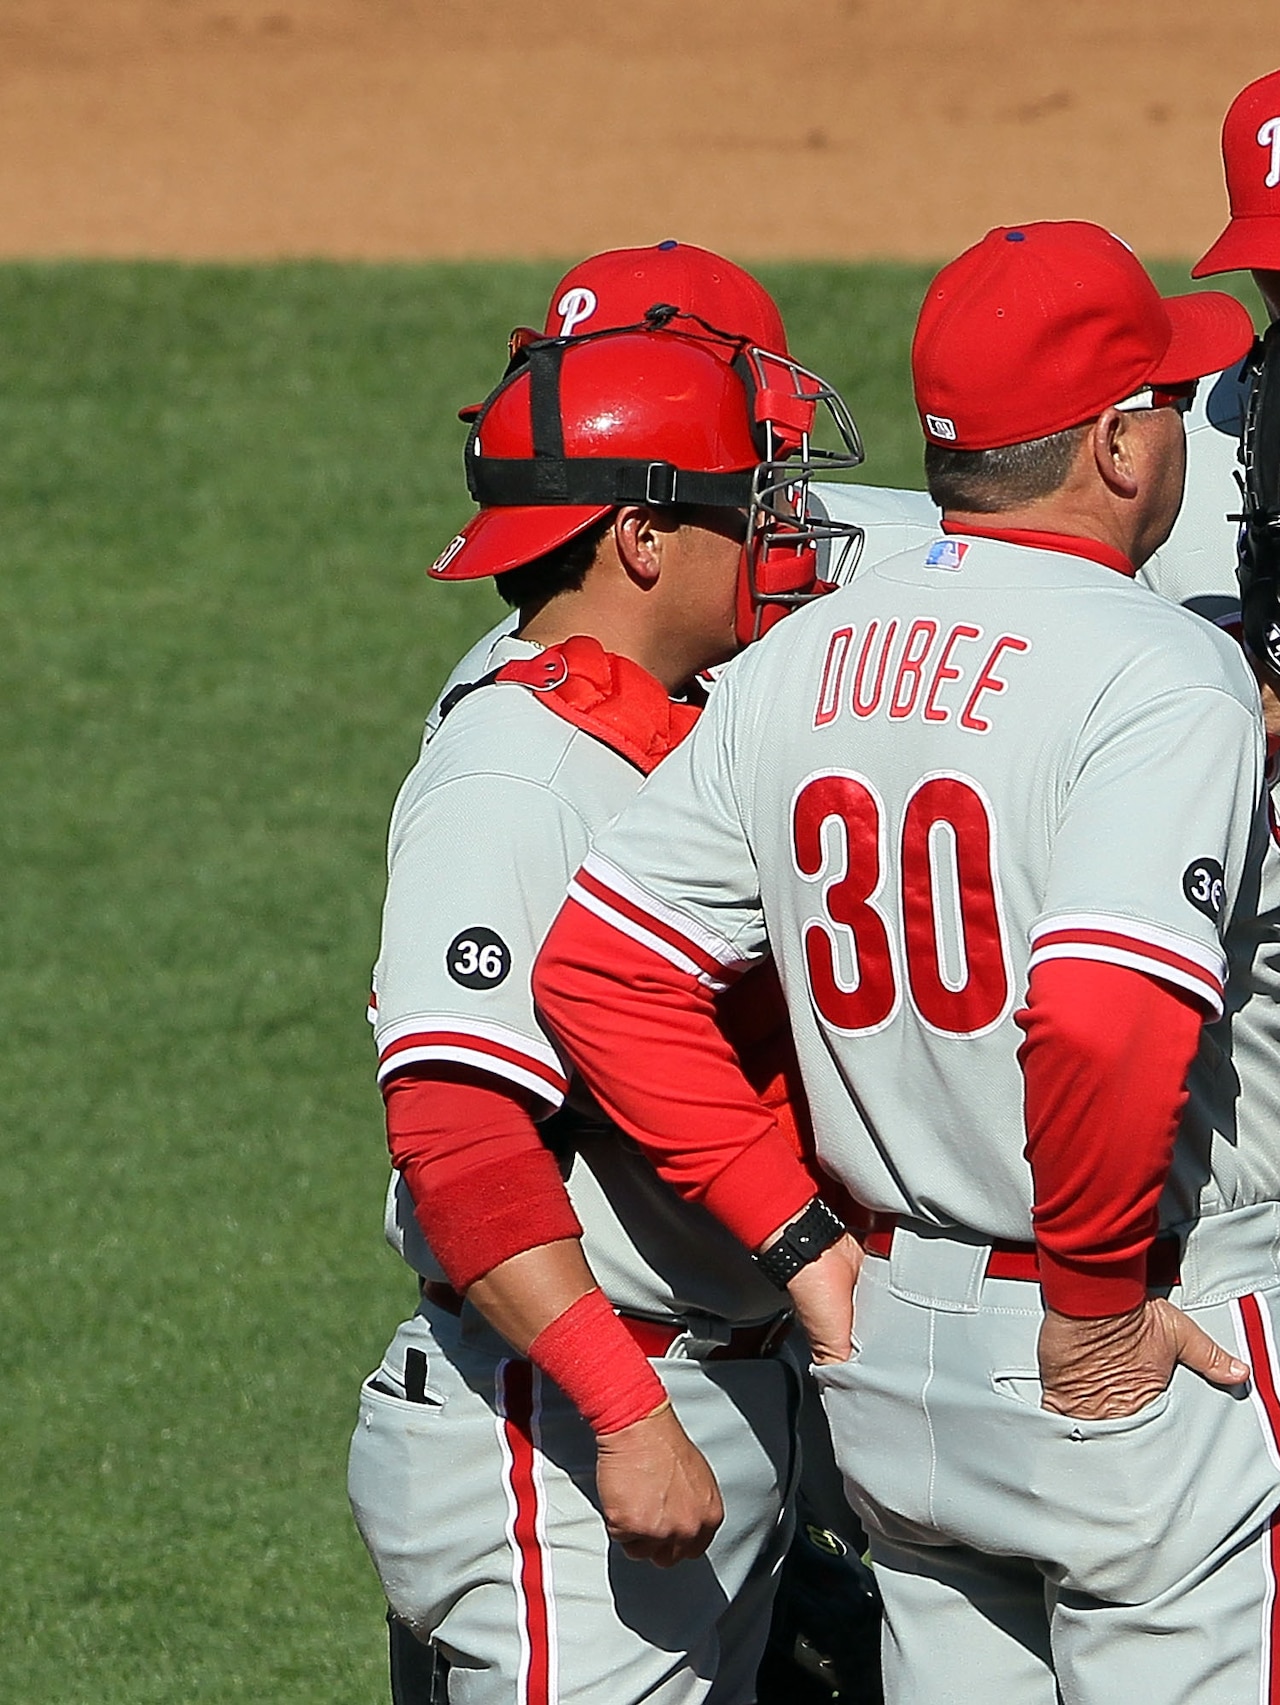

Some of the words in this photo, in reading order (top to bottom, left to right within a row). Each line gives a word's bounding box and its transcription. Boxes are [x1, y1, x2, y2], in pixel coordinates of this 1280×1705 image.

[557, 287, 597, 337] P
[812, 616, 1032, 736] DUBEE
[790, 766, 1016, 1040] 30
[454, 939, 503, 979] 36
